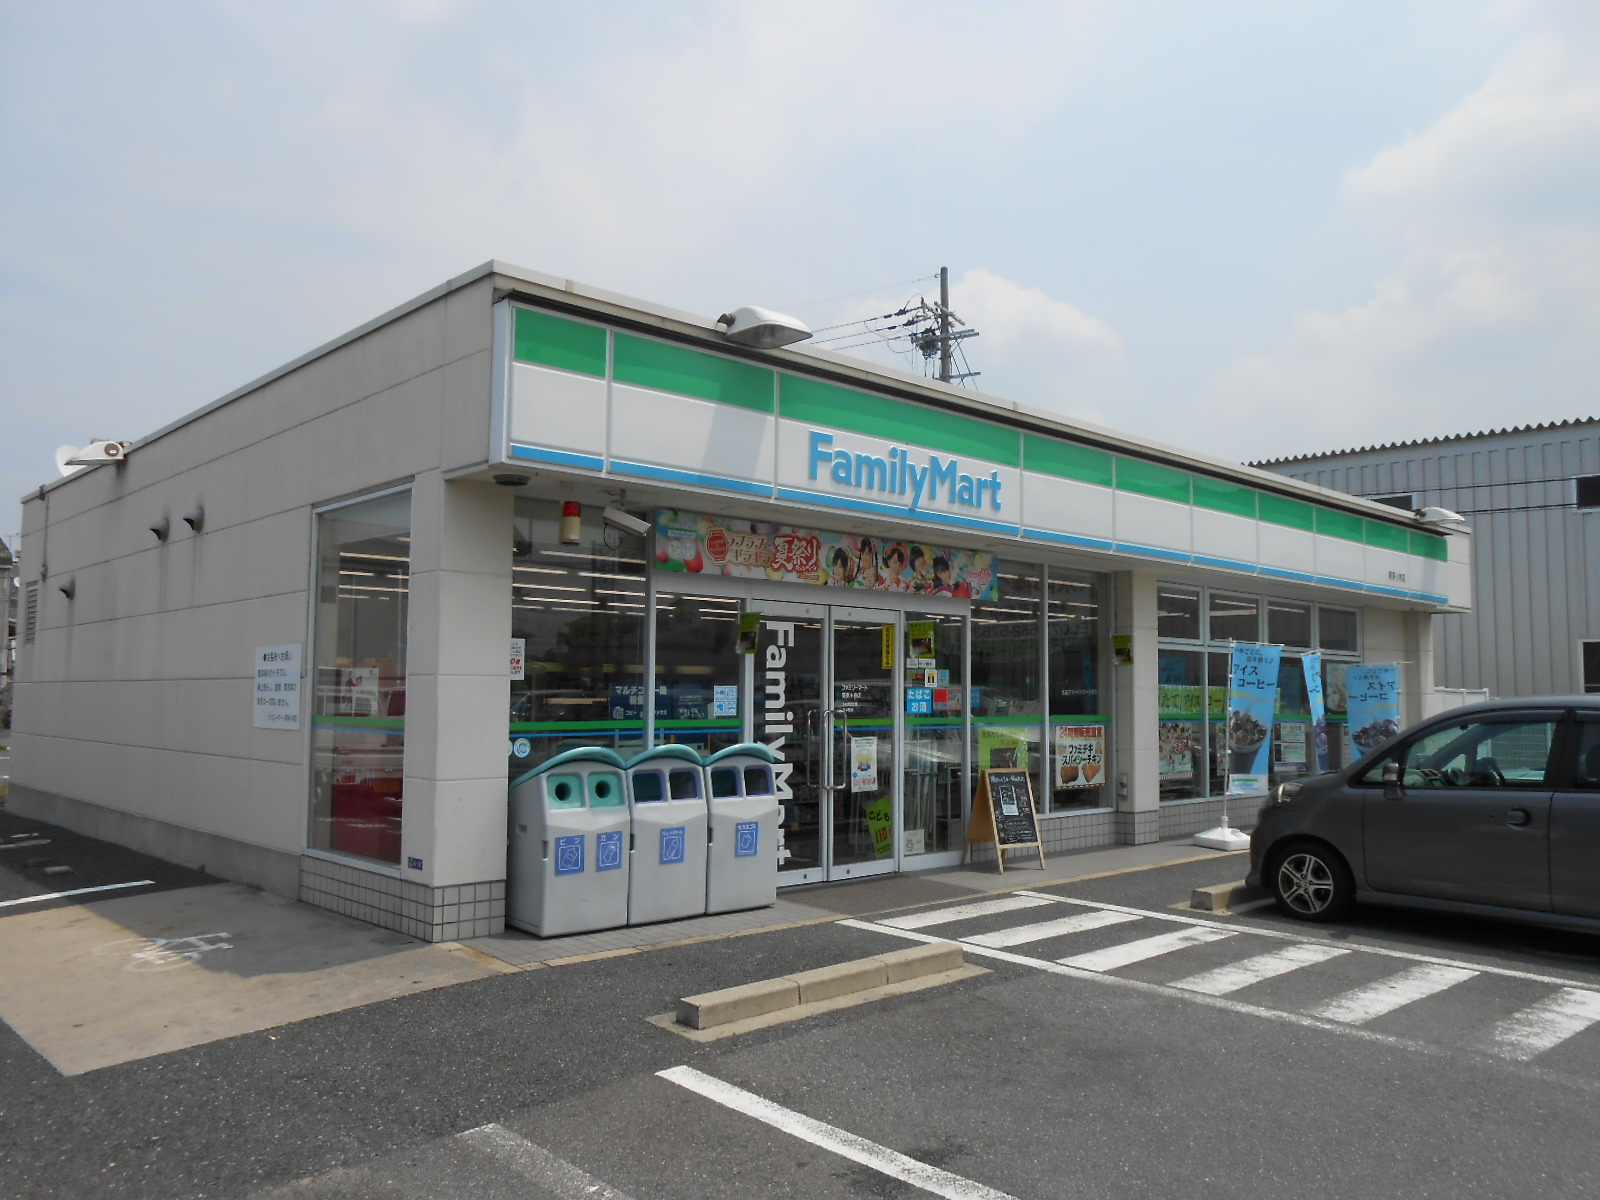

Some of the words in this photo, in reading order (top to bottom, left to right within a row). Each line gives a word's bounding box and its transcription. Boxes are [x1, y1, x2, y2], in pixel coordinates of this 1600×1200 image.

[809, 430, 1002, 510] FamilyMart
[771, 536, 818, 571] 夏祭り
[1233, 664, 1259, 676] アイス
[615, 685, 667, 695] マルチコー機
[841, 683, 869, 692] ファミリーマート
[1238, 678, 1275, 690] コーヒー
[907, 690, 930, 699] たばこ
[911, 701, 927, 713] お酒
[868, 809, 890, 822] こども
[600, 833, 619, 842] カン
[875, 825, 891, 844] 110
[559, 837, 581, 846] ビン
